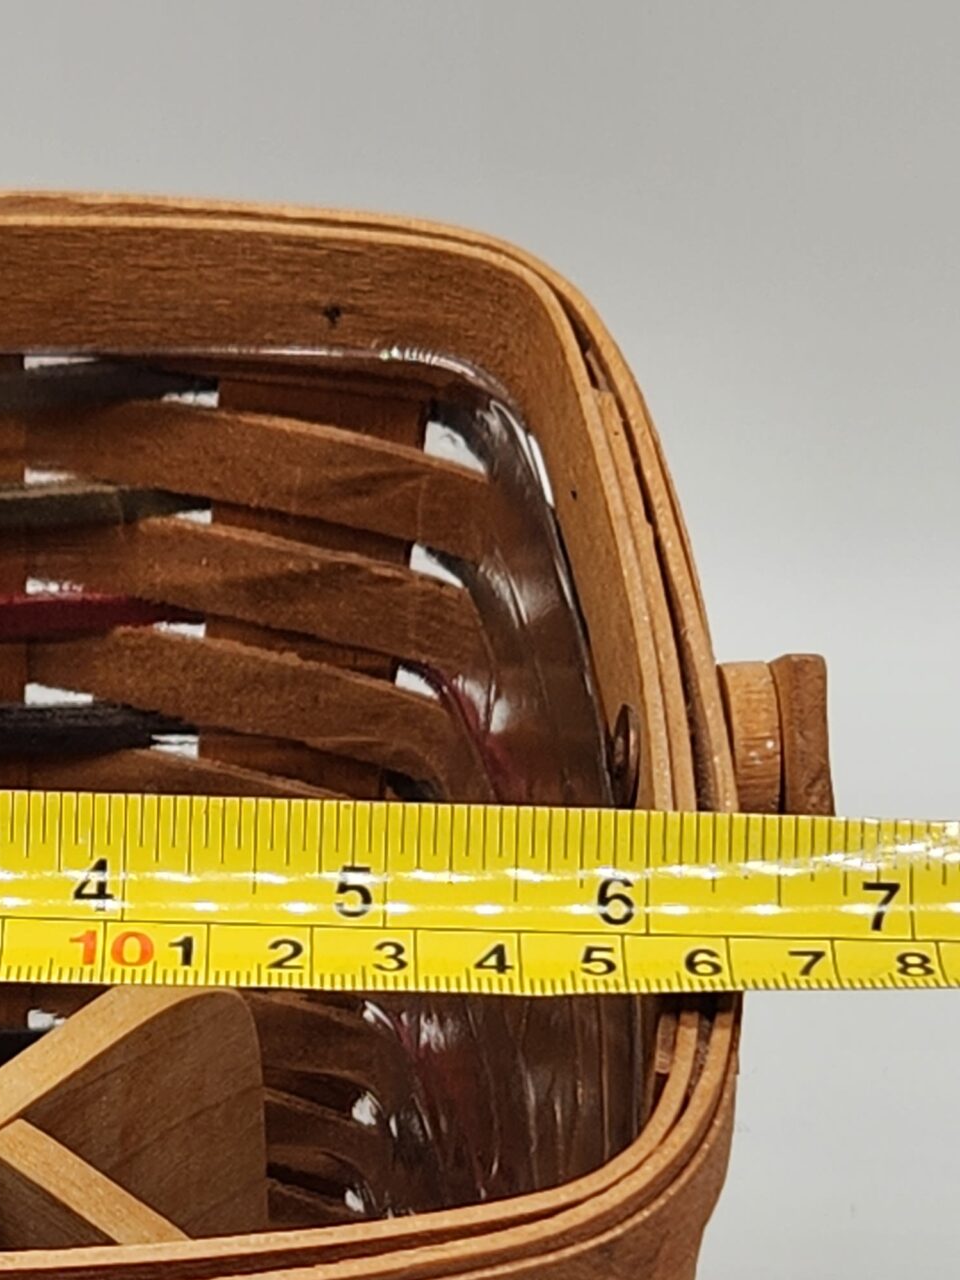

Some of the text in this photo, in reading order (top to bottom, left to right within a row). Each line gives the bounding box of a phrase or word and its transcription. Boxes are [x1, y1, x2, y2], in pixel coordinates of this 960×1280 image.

[73, 858, 114, 911] 4
[335, 866, 374, 918] 5
[597, 877, 635, 926] 6
[862, 882, 902, 932] 7
[69, 930, 154, 966] 10
[170, 936, 195, 967] 1
[266, 939, 305, 970] 2
[372, 942, 408, 973] 3
[473, 943, 514, 974] 4
[580, 947, 617, 975] 5
[683, 948, 722, 977] 6
[786, 950, 827, 977] 7
[896, 952, 935, 977] 8
